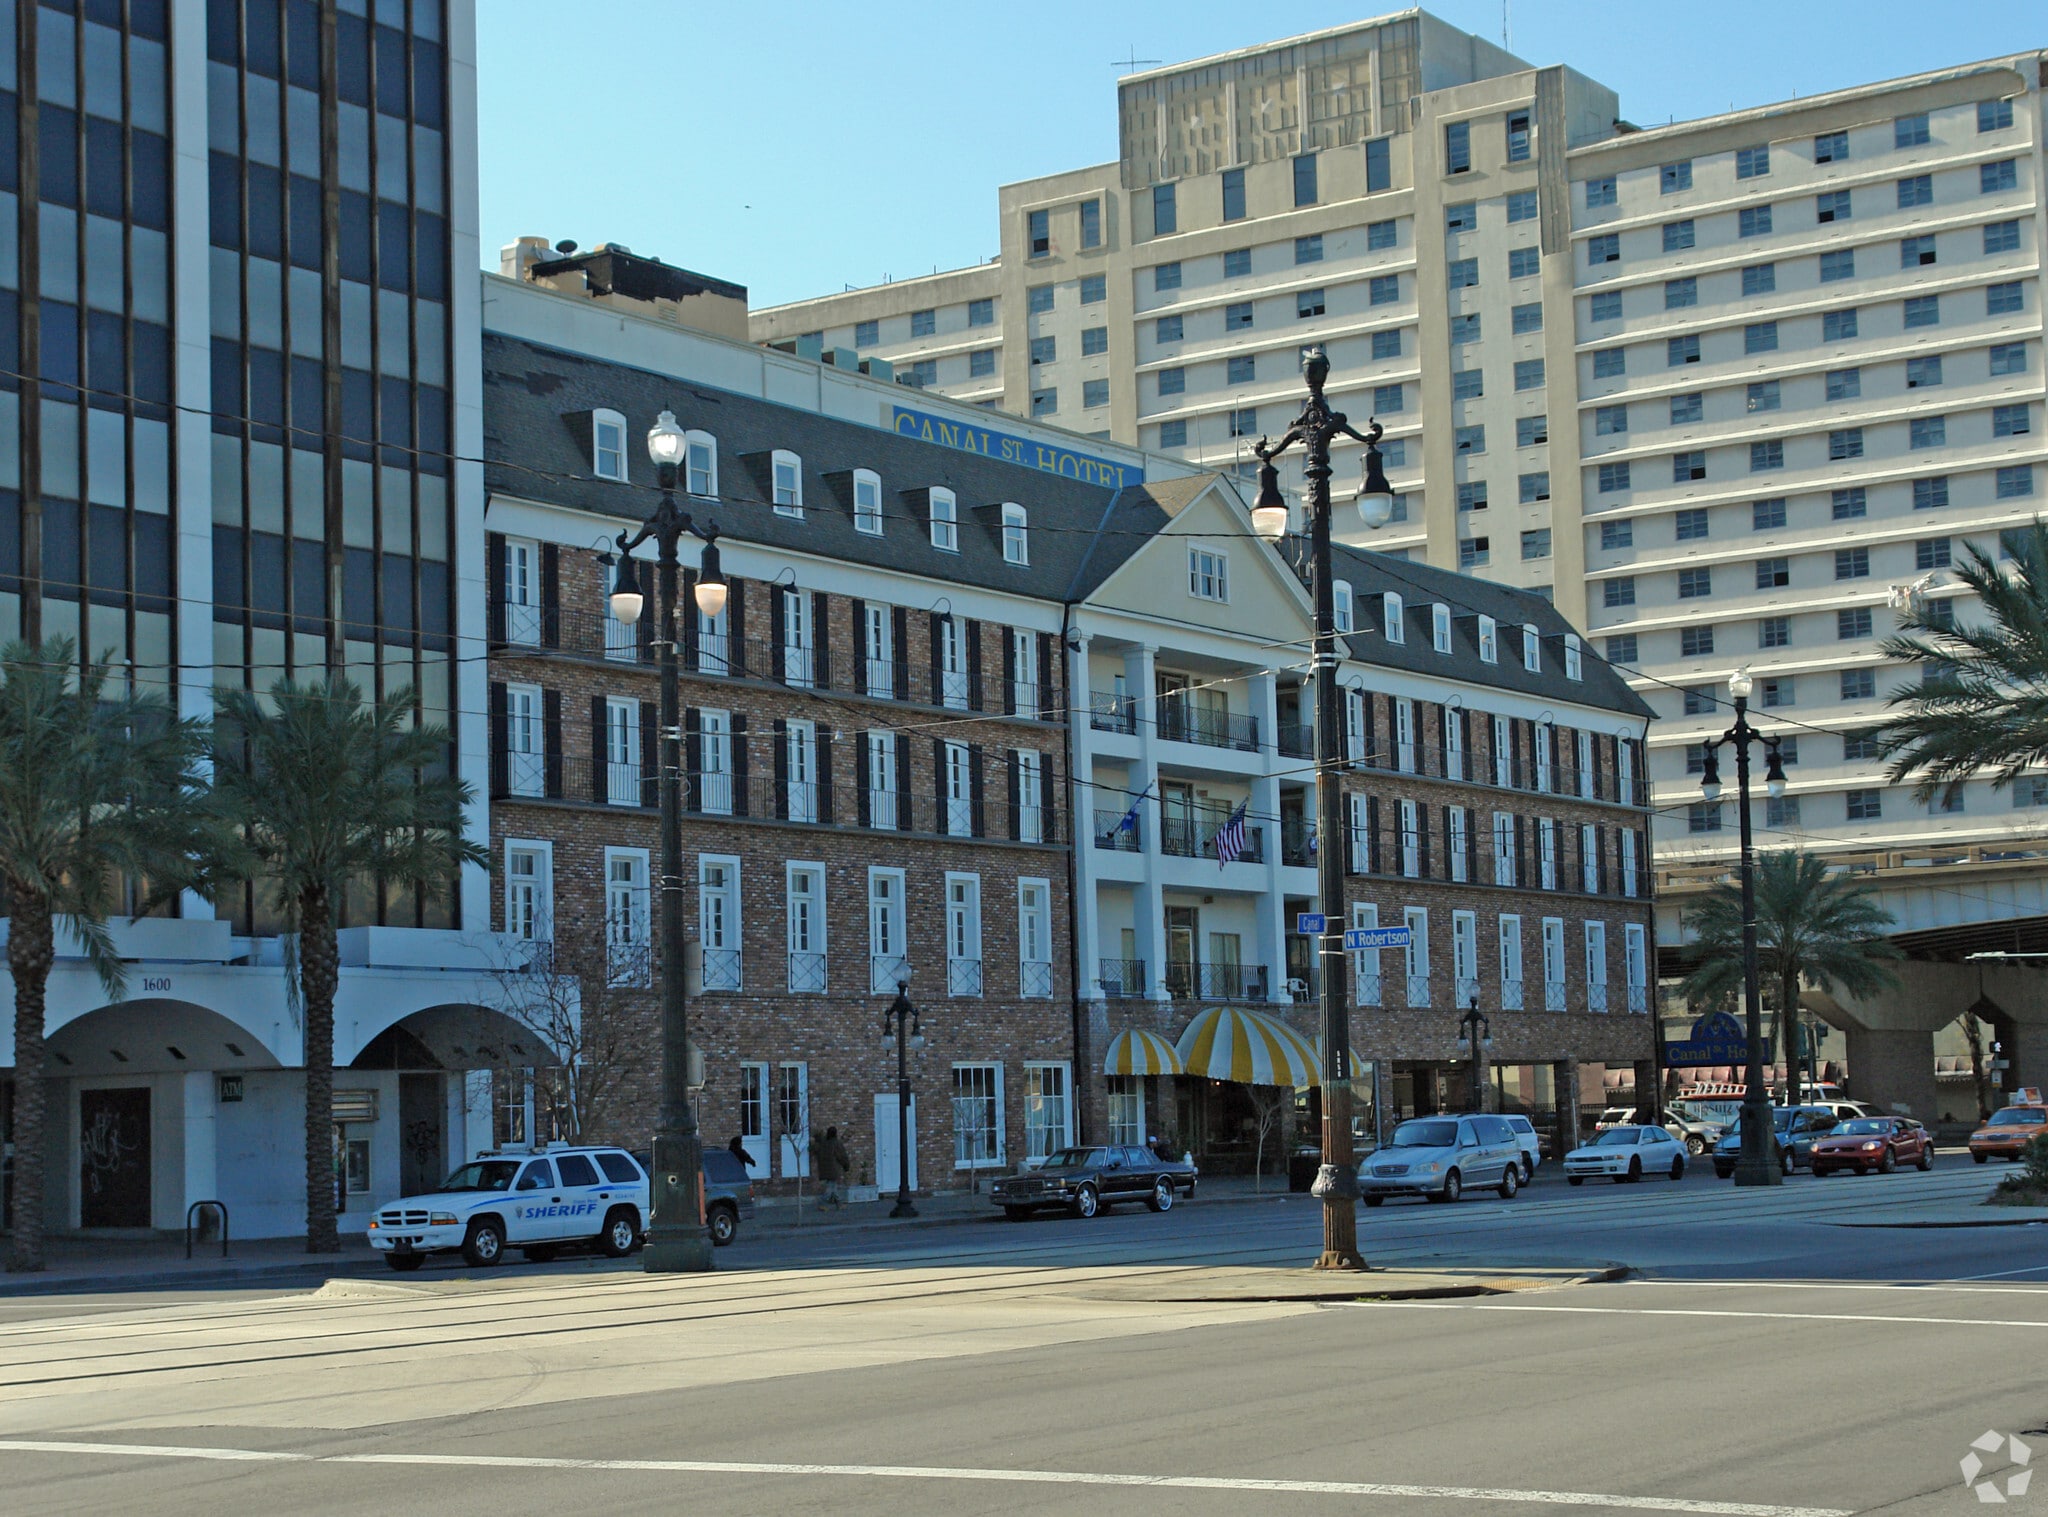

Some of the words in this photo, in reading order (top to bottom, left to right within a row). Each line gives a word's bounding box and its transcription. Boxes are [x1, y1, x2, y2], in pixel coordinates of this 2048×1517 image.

[1001, 437, 1028, 464] ST.
[1302, 916, 1320, 931] Canal
[1347, 935, 1355, 947] N
[1359, 931, 1409, 946] Robertson
[143, 977, 171, 991] 1600
[1669, 1045, 1712, 1061] Canal
[222, 1081, 241, 1097] ATM
[525, 1203, 598, 1219] SHERIFF
